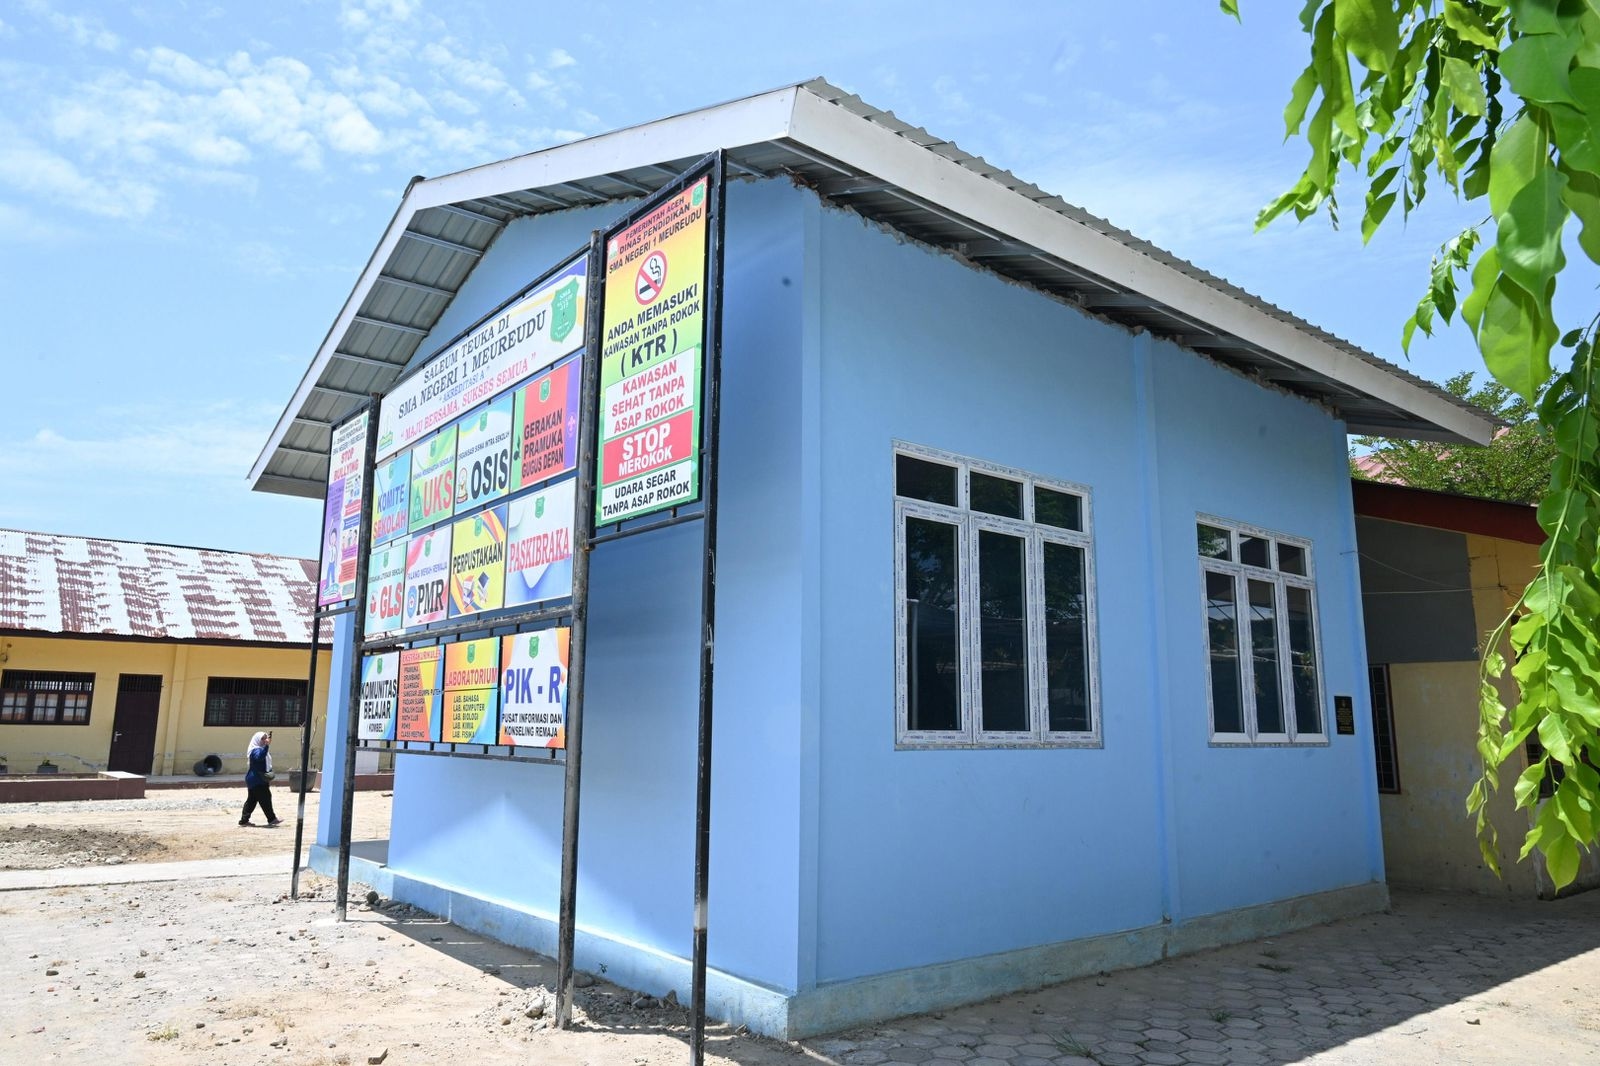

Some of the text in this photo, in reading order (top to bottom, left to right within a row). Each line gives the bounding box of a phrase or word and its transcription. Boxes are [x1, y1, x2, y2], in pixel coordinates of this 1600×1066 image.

[619, 204, 690, 255] DINAS PENDIDIKAN
[625, 196, 685, 239] PEMERINTAH ACEH
[609, 208, 702, 274] SMA NEGERI 1 MEUREUDU
[603, 329, 640, 359] KAWASAN
[642, 319, 668, 340] TANPA
[670, 300, 700, 326] ROKOK
[607, 321, 635, 342] ANDA
[637, 283, 698, 326] MEMASUKI
[399, 399, 417, 419] SMA
[420, 369, 458, 406] NEGERI
[463, 363, 468, 378] 1
[472, 310, 547, 372] MEUREUDU
[424, 314, 510, 384] SALEUM TEUKA DI
[631, 334, 666, 368] KTR
[479, 371, 485, 380] A
[622, 360, 677, 395] KAWASAN
[404, 422, 422, 441] MAJU
[424, 402, 460, 430] BERSAMA,
[462, 379, 495, 407] SUKSES
[496, 359, 529, 387] SEMUA
[612, 375, 685, 417] SEHAT TANPA
[614, 393, 685, 434] ASAP ROKOK
[524, 408, 563, 440] GERAKAN
[622, 422, 671, 461] STOP
[341, 447, 355, 464] STOP
[523, 428, 563, 459] PRAMUKA
[618, 445, 673, 477] MEROKOK
[470, 448, 509, 500] OSIS
[522, 447, 564, 478] GUGUS DEPAN
[377, 483, 405, 514] KOMITE
[423, 469, 453, 518] UKS
[602, 480, 690, 518] TANPA ASAP ROKOK
[614, 469, 676, 499] UDARA SEGAR
[373, 509, 407, 540] SEKOLAH
[452, 541, 504, 575] PERPUSTAKAAN
[508, 527, 571, 573] PASKIBRAKA
[380, 582, 403, 619] GLS
[416, 578, 445, 616] PMR
[360, 678, 397, 700] KOMUNITAS
[445, 667, 498, 686] LABORATORIUM
[505, 667, 534, 704] PIK
[548, 666, 562, 704] R
[363, 700, 391, 720] BELAJAR
[462, 694, 479, 702] BAHASA
[502, 713, 562, 725] PUSAT INFORMASI DAN
[504, 726, 558, 737] KONSELING REMAJA
